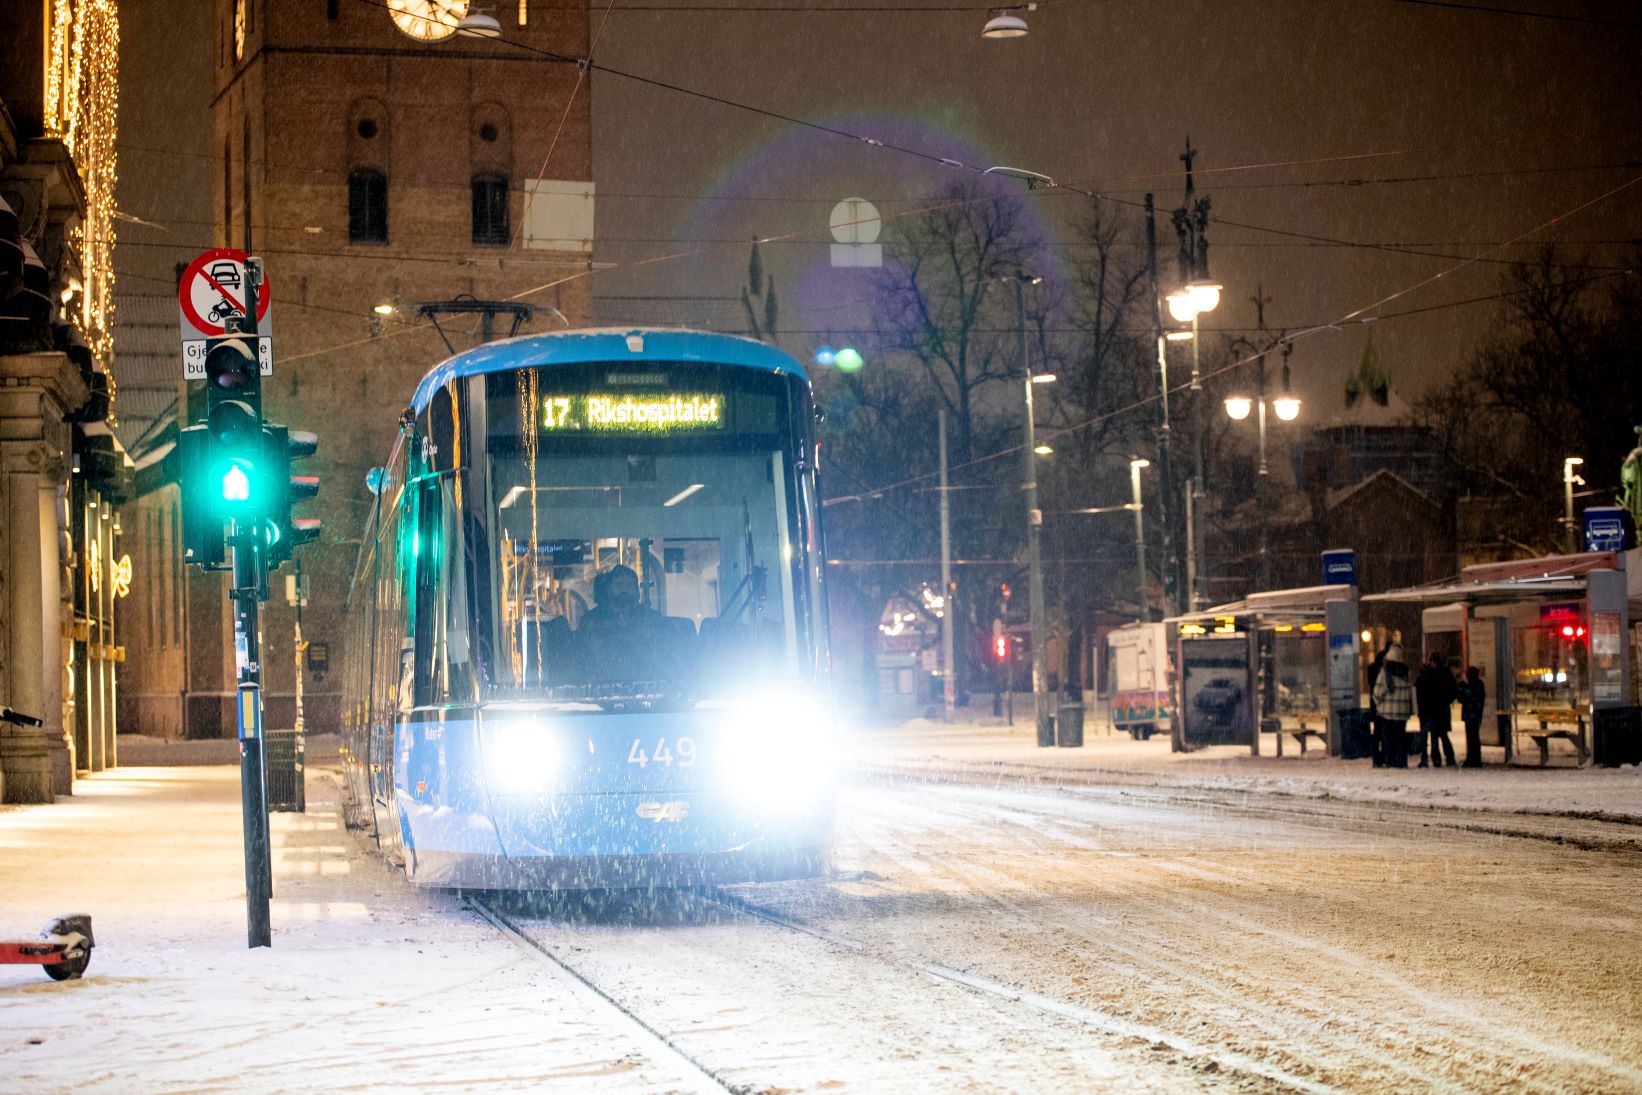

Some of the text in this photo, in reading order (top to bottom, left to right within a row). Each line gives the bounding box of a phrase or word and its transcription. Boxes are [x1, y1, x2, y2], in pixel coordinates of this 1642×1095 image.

[544, 396, 718, 428] 17 Rikshospitalet
[627, 736, 697, 769] 449
